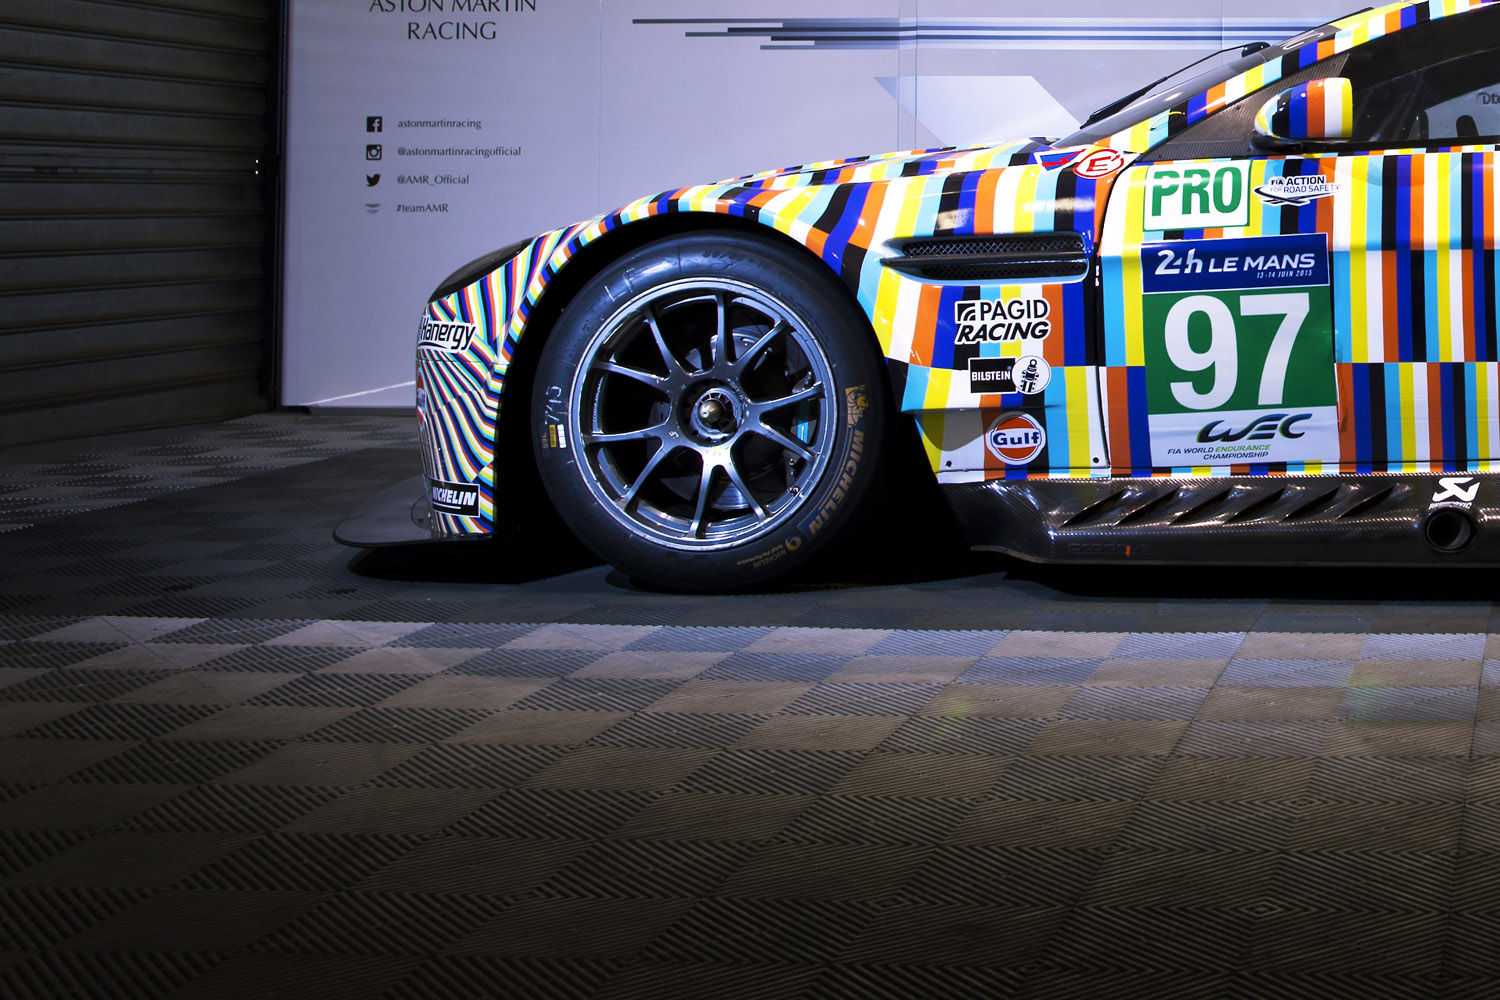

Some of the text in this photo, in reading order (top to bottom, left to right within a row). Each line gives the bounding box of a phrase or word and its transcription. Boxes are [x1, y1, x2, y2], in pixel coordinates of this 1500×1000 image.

[407, 21, 496, 40] RACING
[397, 119, 482, 130] astonmartinracing
[397, 146, 521, 158] @astonmartinracingofficial
[397, 175, 470, 186] @AMR_Official
[1286, 176, 1325, 186] ACTION
[1151, 166, 1243, 217] PRO
[1283, 186, 1307, 194] ROAD
[1308, 183, 1341, 192] SAFETY
[397, 203, 449, 213] #teamAMR
[1208, 257, 1239, 273] LE
[1243, 253, 1315, 271] MANS
[1277, 270, 1294, 278] JUIN
[1295, 269, 1313, 277] 2015
[980, 299, 1049, 321] PAGID
[422, 317, 477, 351] Hanergy
[957, 321, 1050, 343] RACING
[1163, 292, 1311, 411] 97
[971, 370, 1011, 382] BILSTEIN
[1195, 413, 1313, 444] WEC
[992, 432, 1040, 446] Gulf
[1215, 444, 1271, 453] ENDURANCE
[1203, 451, 1269, 461] CHAMPIONSHIP
[809, 429, 865, 535] MICHELIN
[432, 486, 477, 506] MICHELIN
